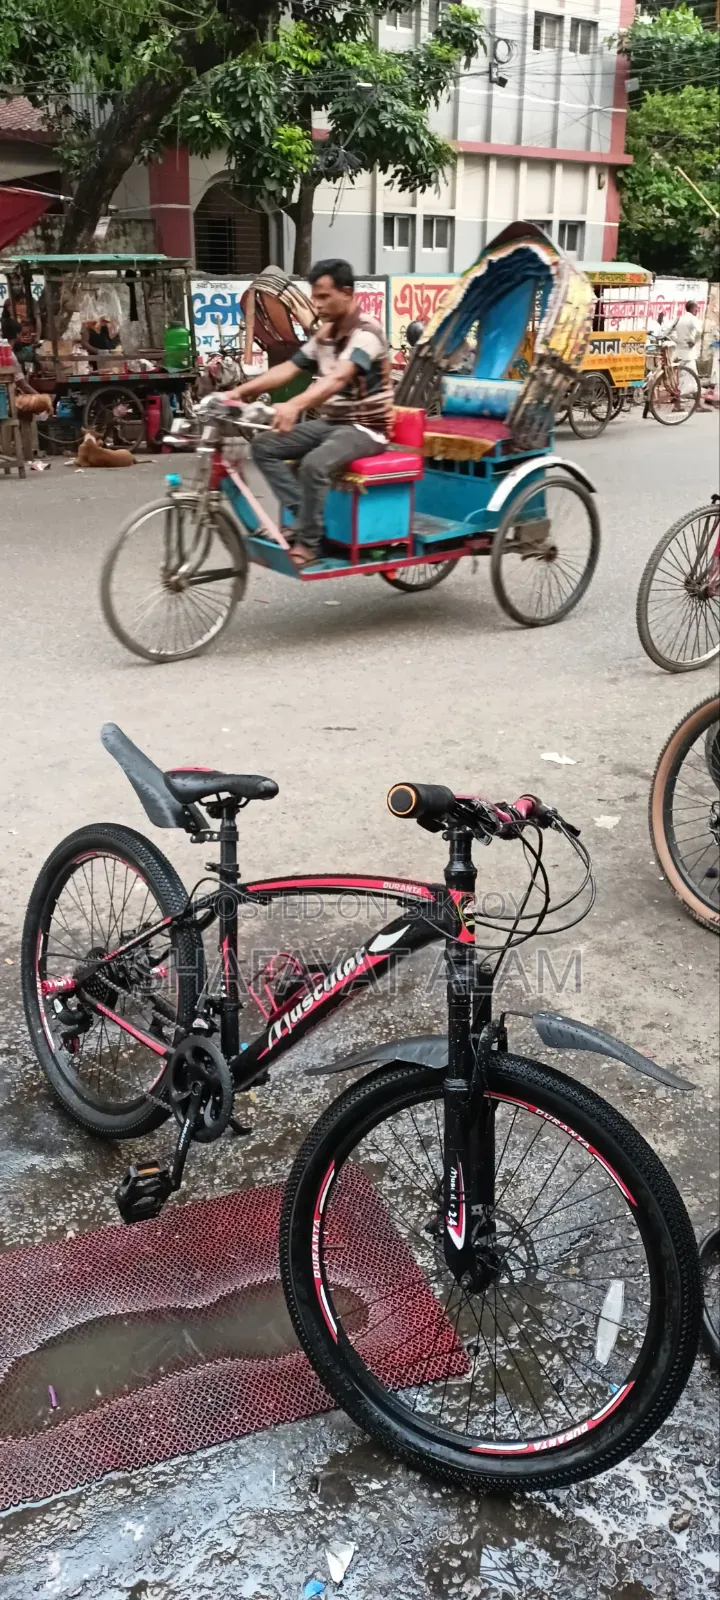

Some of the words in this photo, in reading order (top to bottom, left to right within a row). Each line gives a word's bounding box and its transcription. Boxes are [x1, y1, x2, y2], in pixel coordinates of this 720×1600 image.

[383, 881, 422, 895] DURANTA
[268, 947, 367, 1050] Muscular
[535, 1108, 590, 1149] DURANTA
[311, 1219, 321, 1279] DURANTA
[533, 1422, 589, 1451] DURANTA
